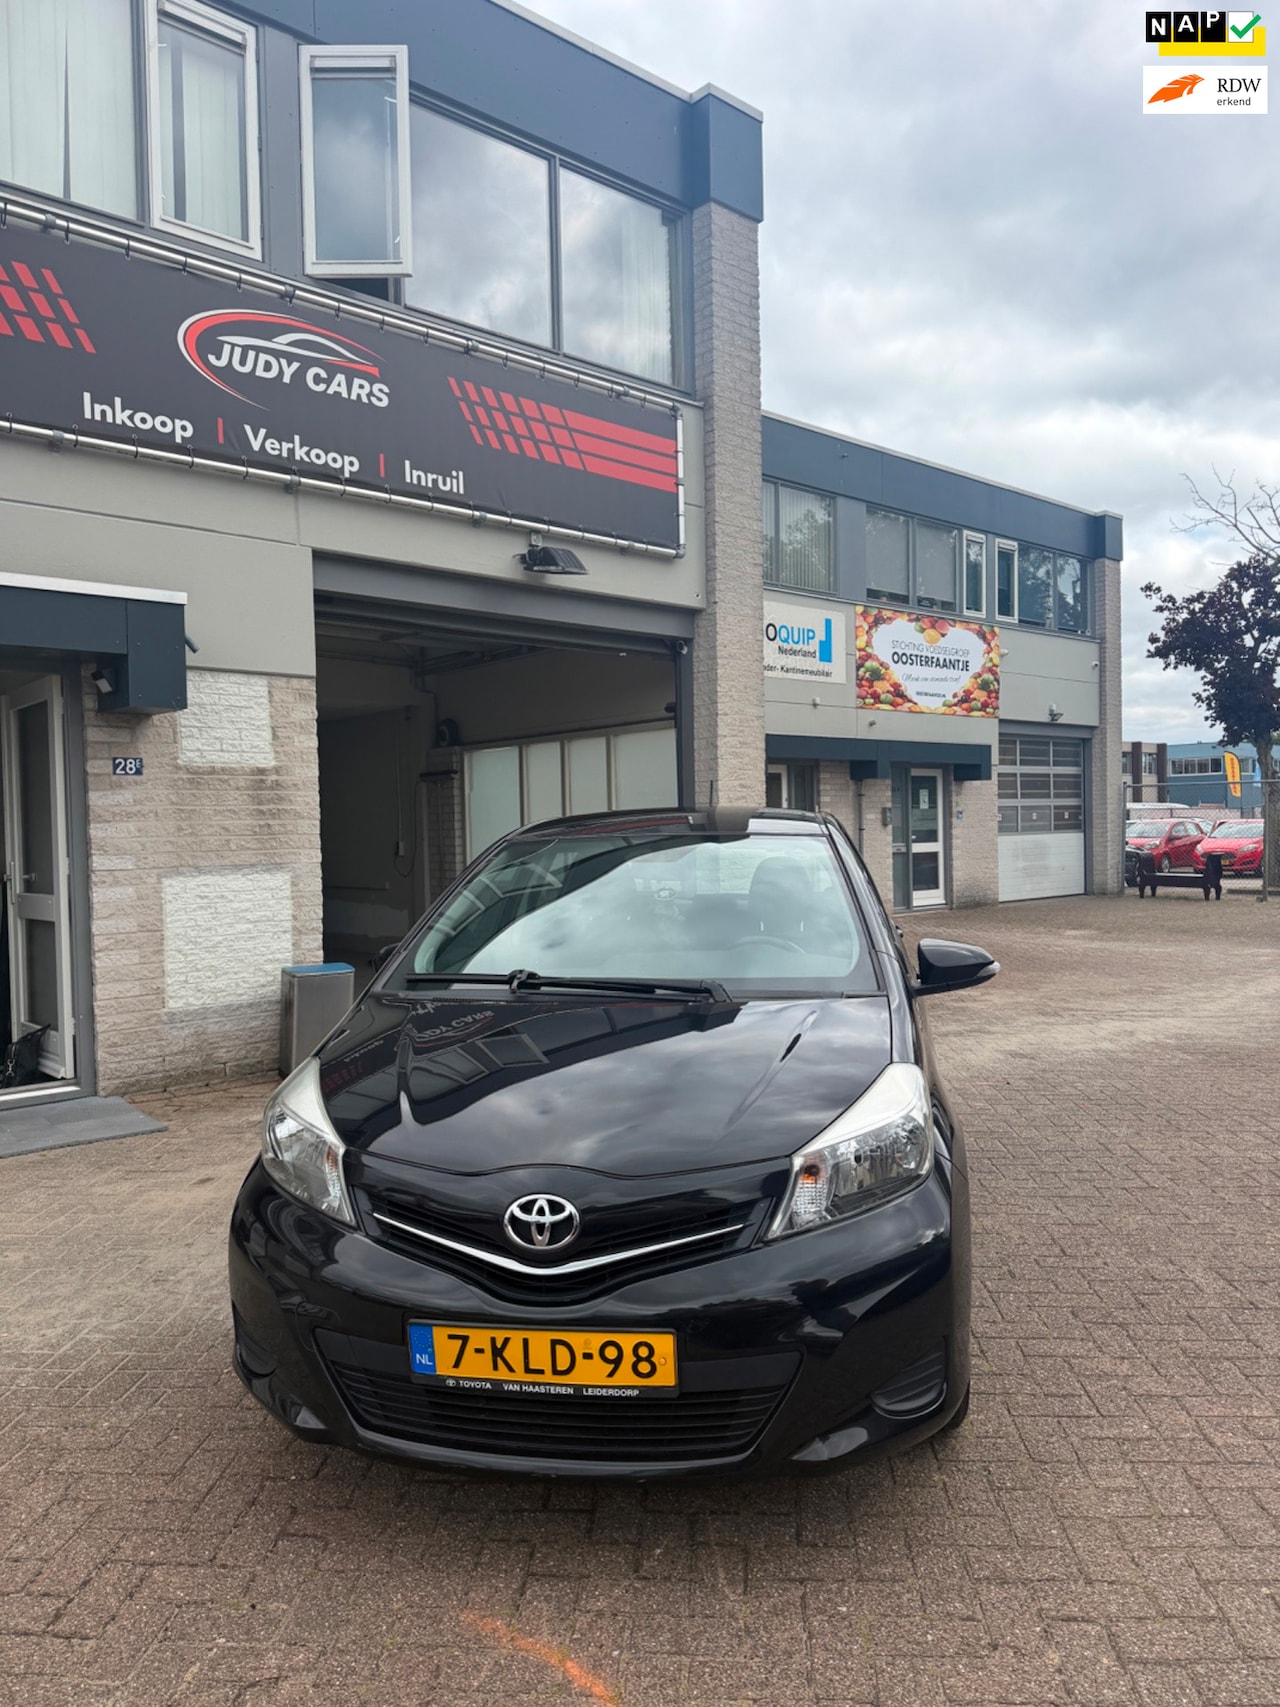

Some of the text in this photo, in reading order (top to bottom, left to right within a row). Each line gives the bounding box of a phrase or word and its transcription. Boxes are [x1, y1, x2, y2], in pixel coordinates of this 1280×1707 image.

[207, 343, 390, 408] JUDY CARS
[83, 391, 465, 495] Inkoop Verkoop Inruil
[778, 645, 817, 659] Nederland
[891, 651, 970, 672] OOSTERFAANTJE
[416, 1353, 433, 1366] NL
[447, 1333, 658, 1379] 7-KLD-98
[459, 1380, 640, 1397] TOYOTA VAN HAASTEREN LEIDERDORP
